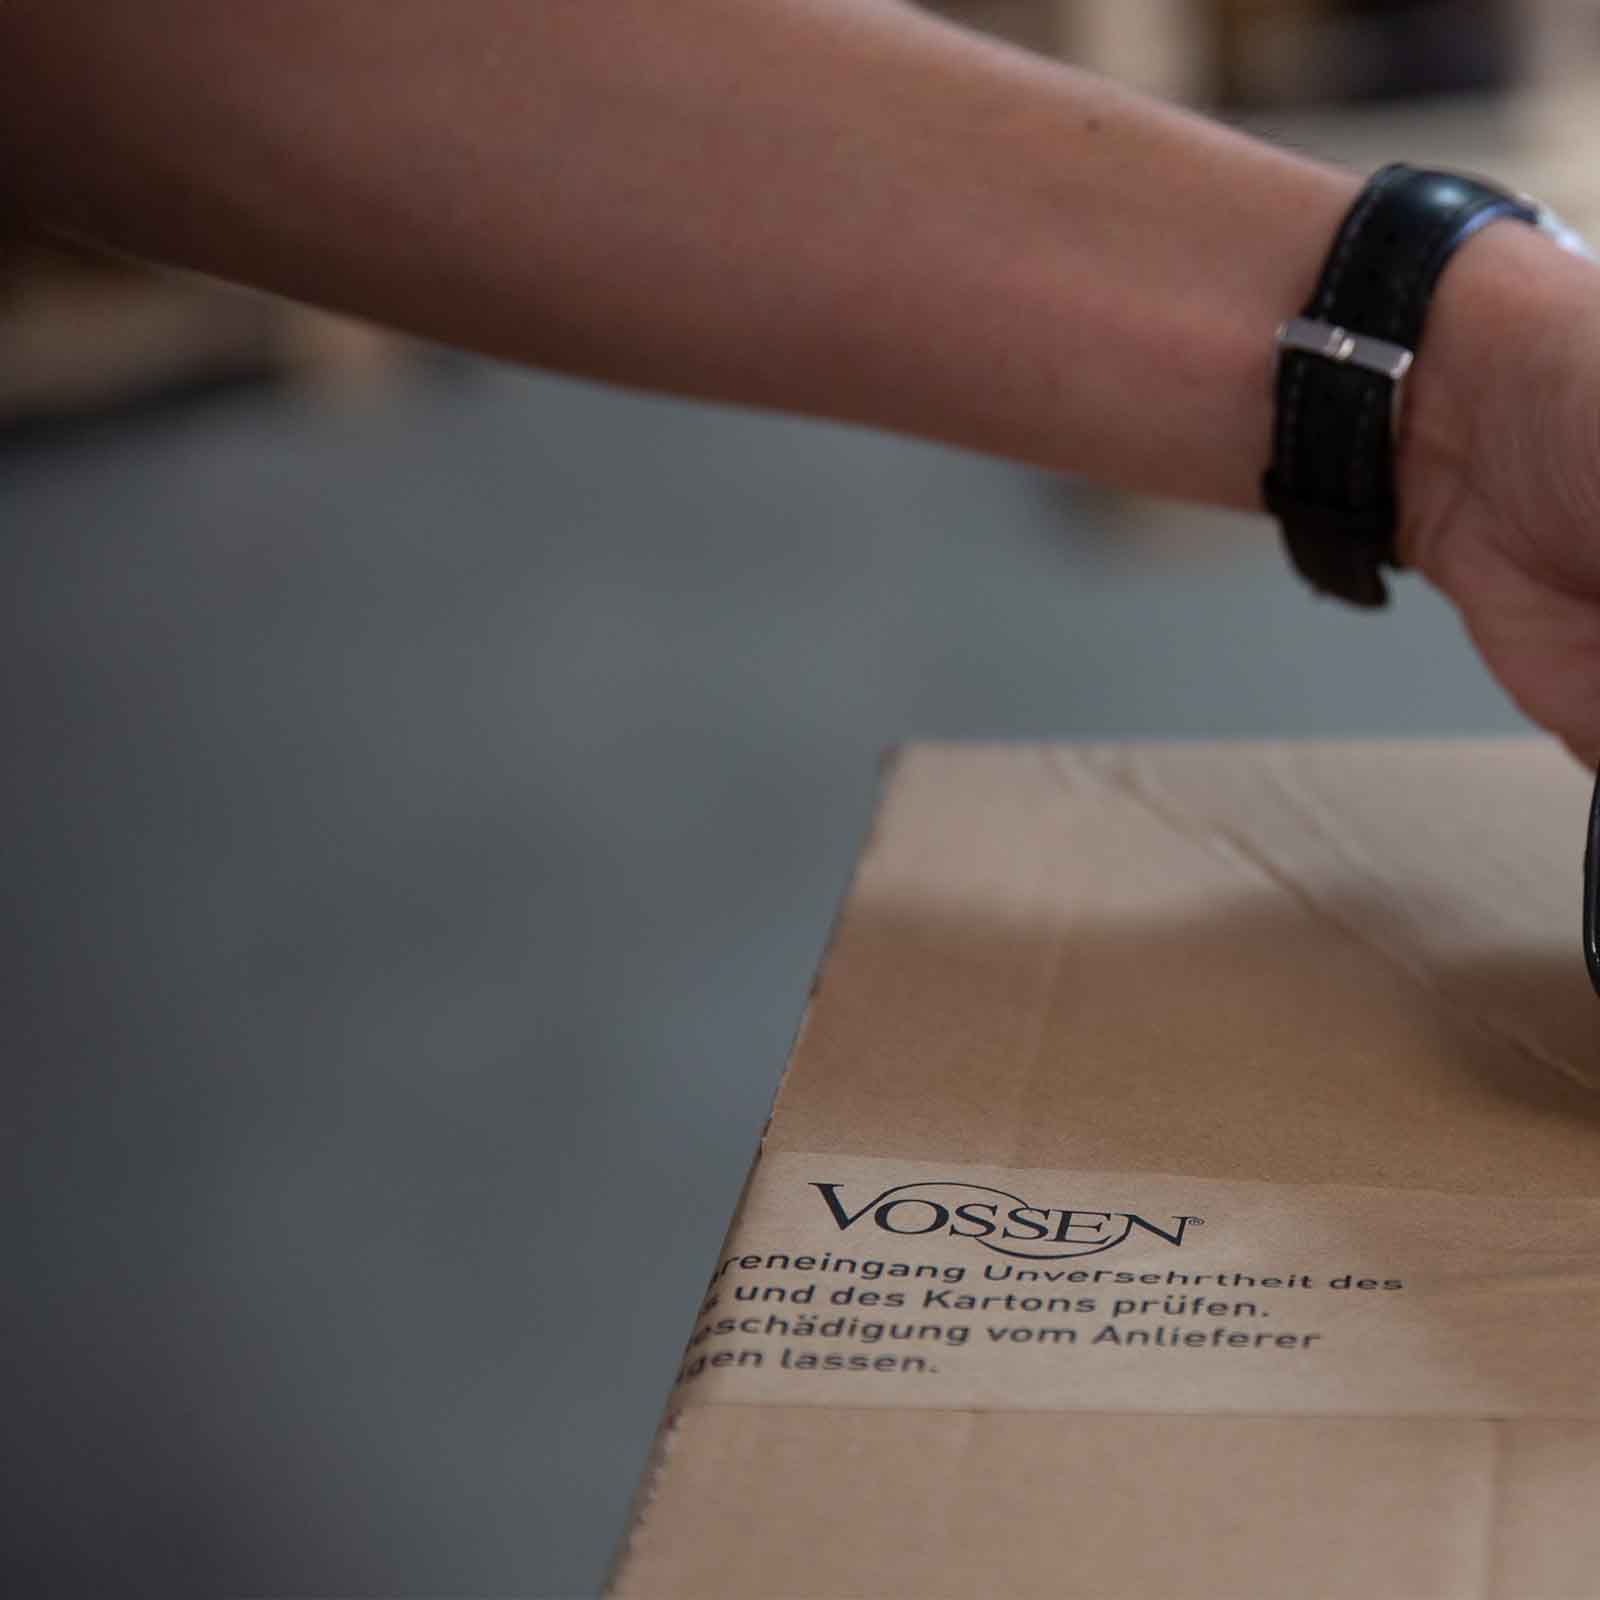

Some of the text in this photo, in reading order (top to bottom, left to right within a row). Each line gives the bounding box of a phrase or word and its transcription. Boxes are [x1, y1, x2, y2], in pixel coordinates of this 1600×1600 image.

[712, 1252, 1404, 1291] reneingang Unversehrtheit des
[734, 1283, 815, 1305] und
[829, 1285, 905, 1307] des
[922, 1288, 1096, 1315] Kartons
[1111, 1293, 1270, 1319] prüfen.
[692, 1313, 1323, 1350] schädigung vom Anlieferer
[779, 1347, 941, 1375] lassen.
